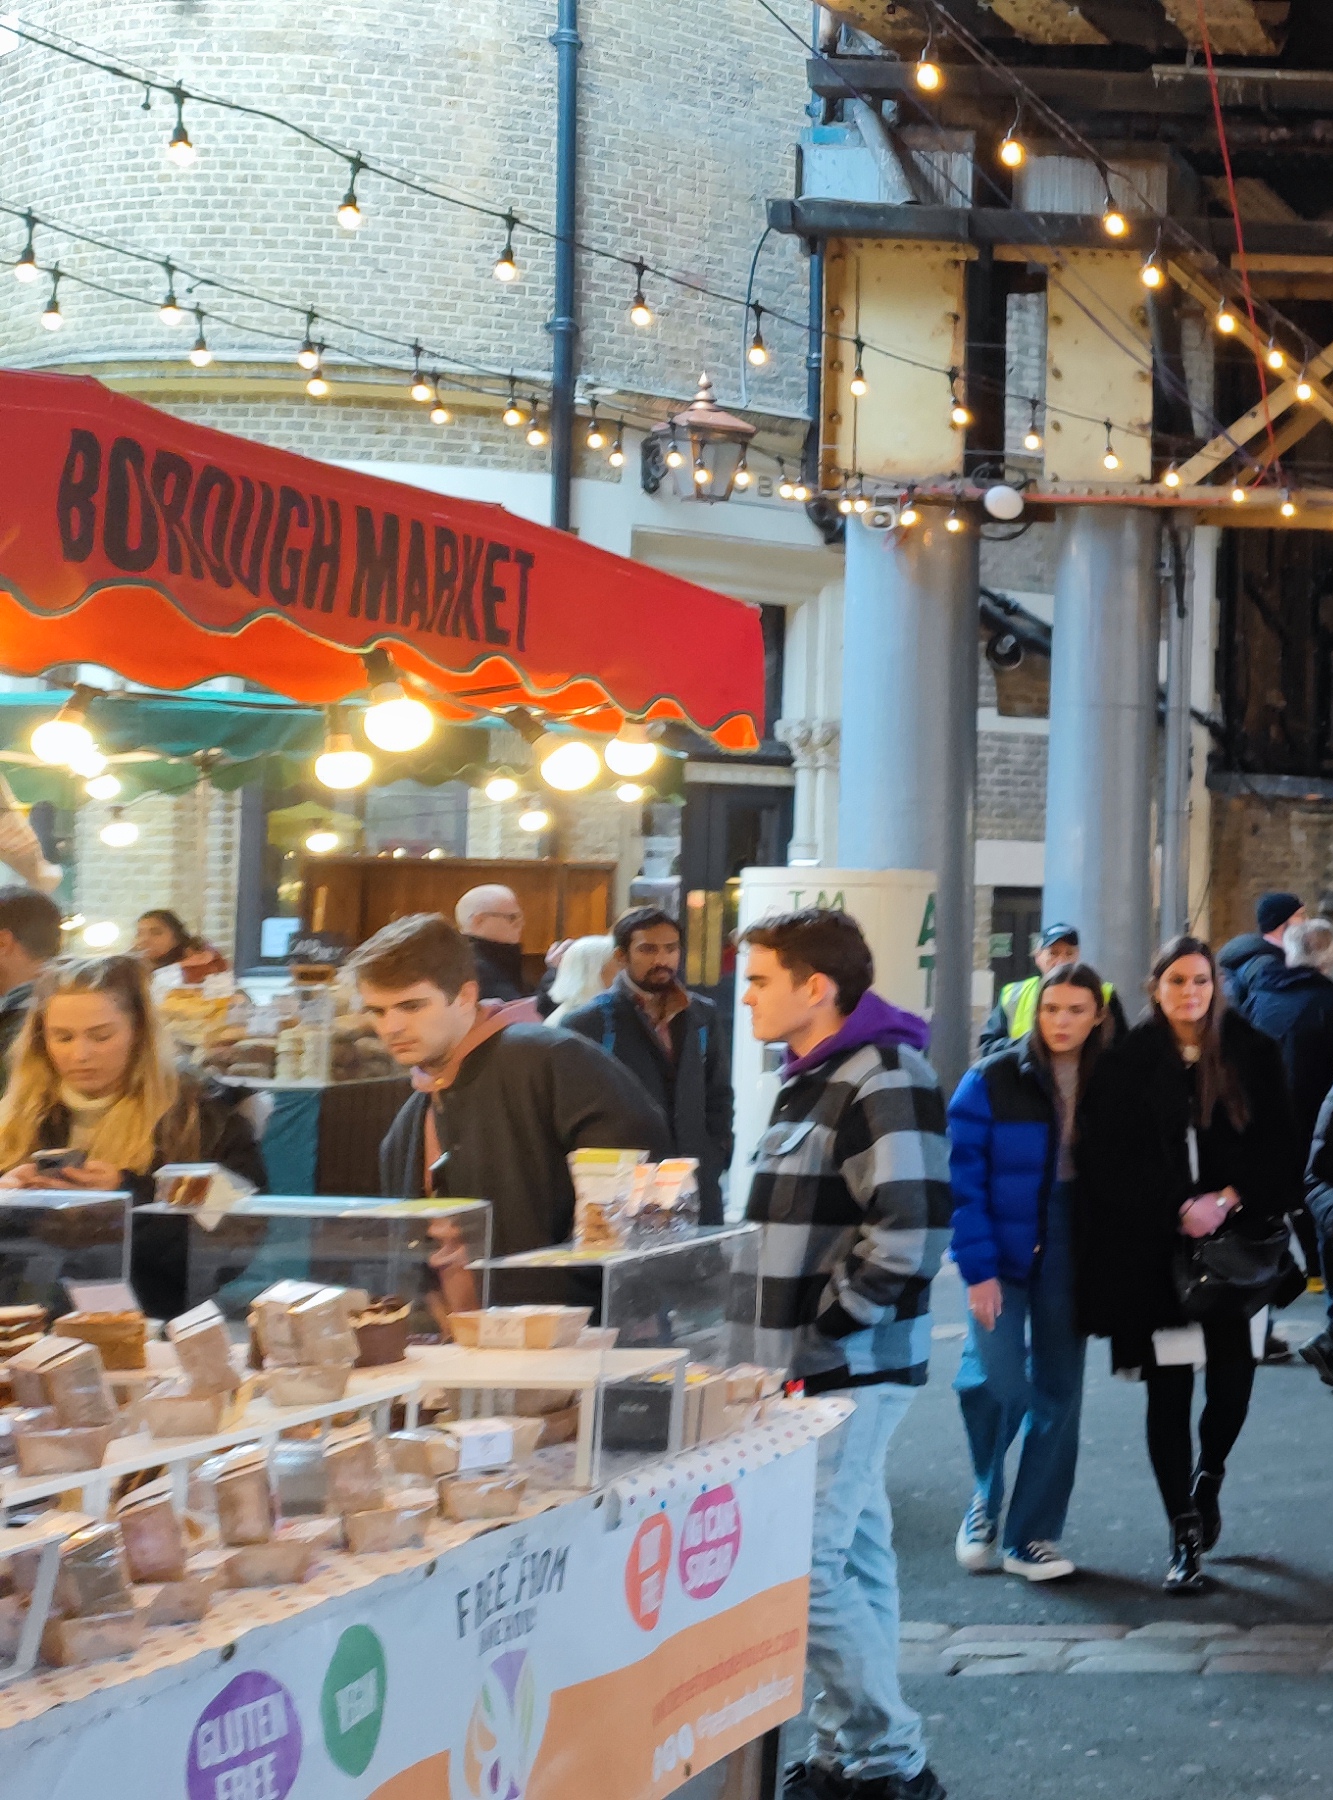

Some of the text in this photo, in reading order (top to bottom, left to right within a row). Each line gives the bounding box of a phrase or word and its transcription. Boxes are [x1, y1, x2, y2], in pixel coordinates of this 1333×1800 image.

[57, 428, 535, 652] BOROUGH MARKET
[456, 1561, 513, 1640] FREE
[196, 1690, 289, 1772] GLUTEN
[214, 1751, 281, 1800] FREE
